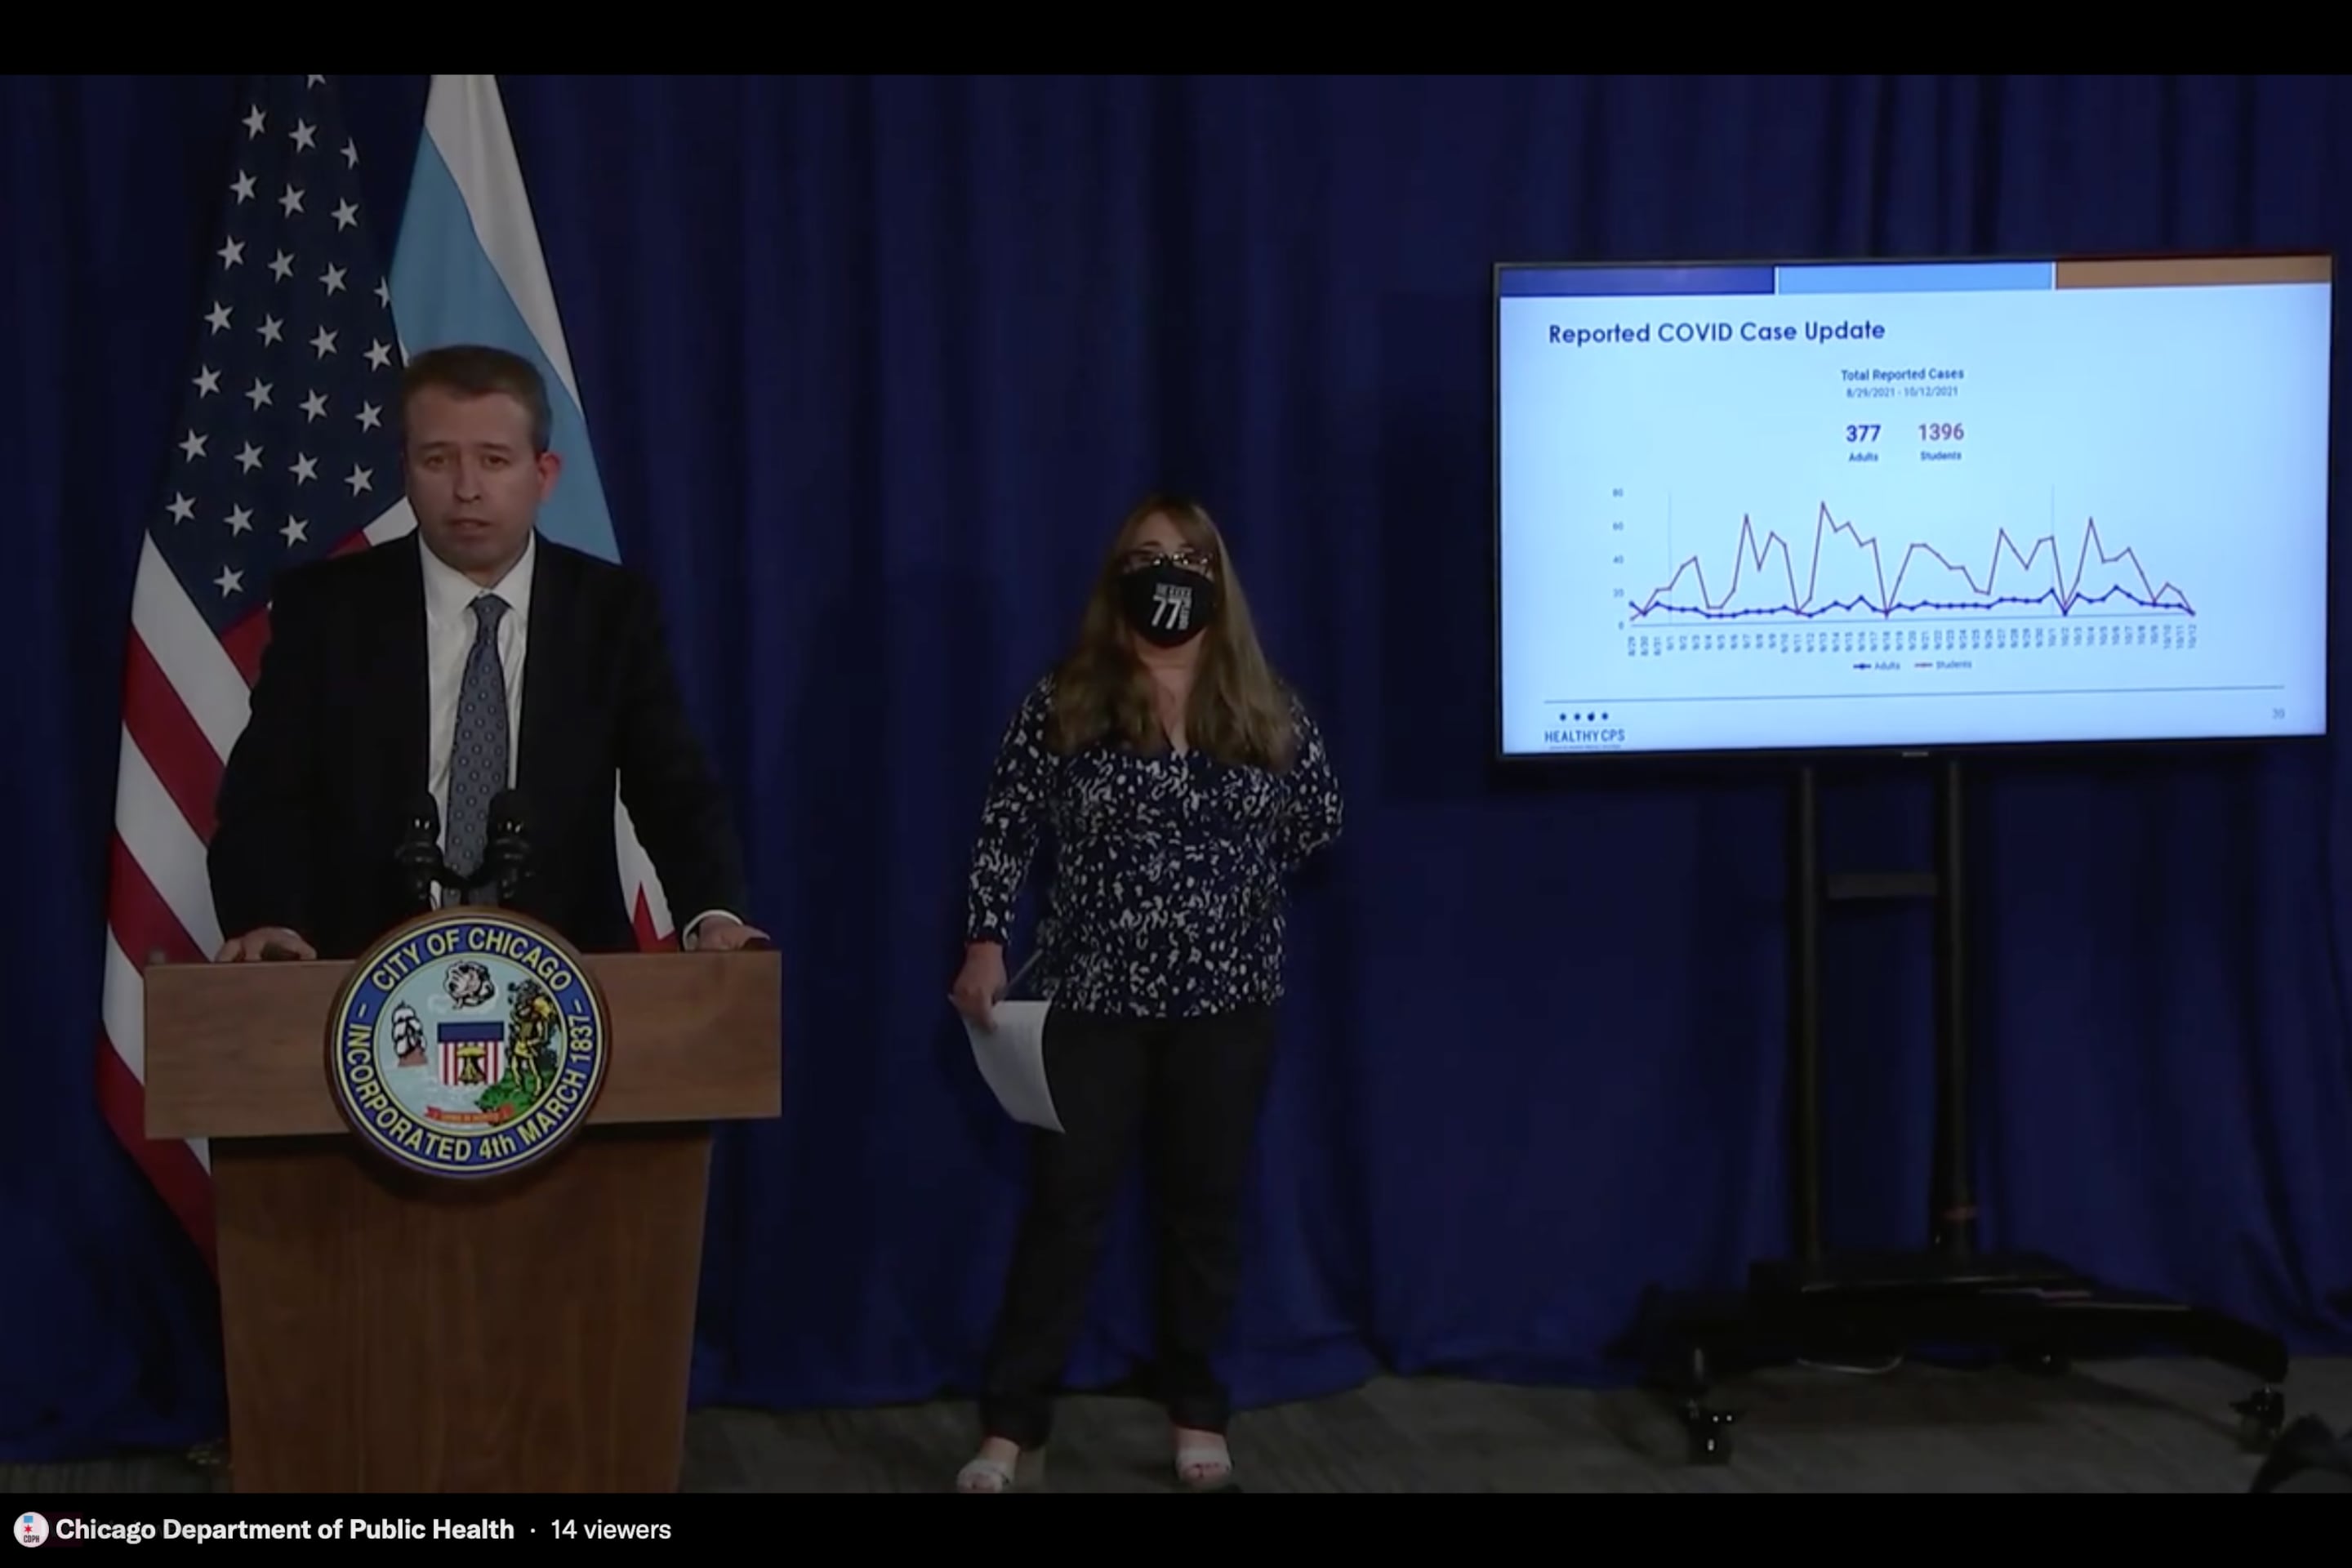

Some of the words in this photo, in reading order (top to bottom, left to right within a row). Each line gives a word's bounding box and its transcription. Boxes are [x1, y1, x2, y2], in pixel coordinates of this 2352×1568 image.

[1549, 323, 1650, 348] Reported
[1657, 322, 1733, 343] COVID
[1740, 321, 1797, 342] Case
[1805, 319, 1886, 345] Update
[1841, 368, 1870, 381] Total
[1872, 368, 1927, 383] Reported
[1927, 368, 1965, 380] Cases
[1846, 424, 1882, 443] 377
[1918, 421, 1965, 442] 1396
[1920, 450, 1962, 461] Students
[1152, 595, 1183, 630] 77
[1544, 729, 1599, 743] HEALTHY
[1600, 728, 1626, 742] CPS
[372, 942, 422, 991] CITY
[426, 929, 461, 953] OF
[468, 927, 572, 991] CHICAGO
[347, 1023, 471, 1161] INCORPORATED
[479, 1134, 517, 1159] 4th
[518, 1070, 587, 1144] MARCH
[570, 1014, 593, 1062] 1837
